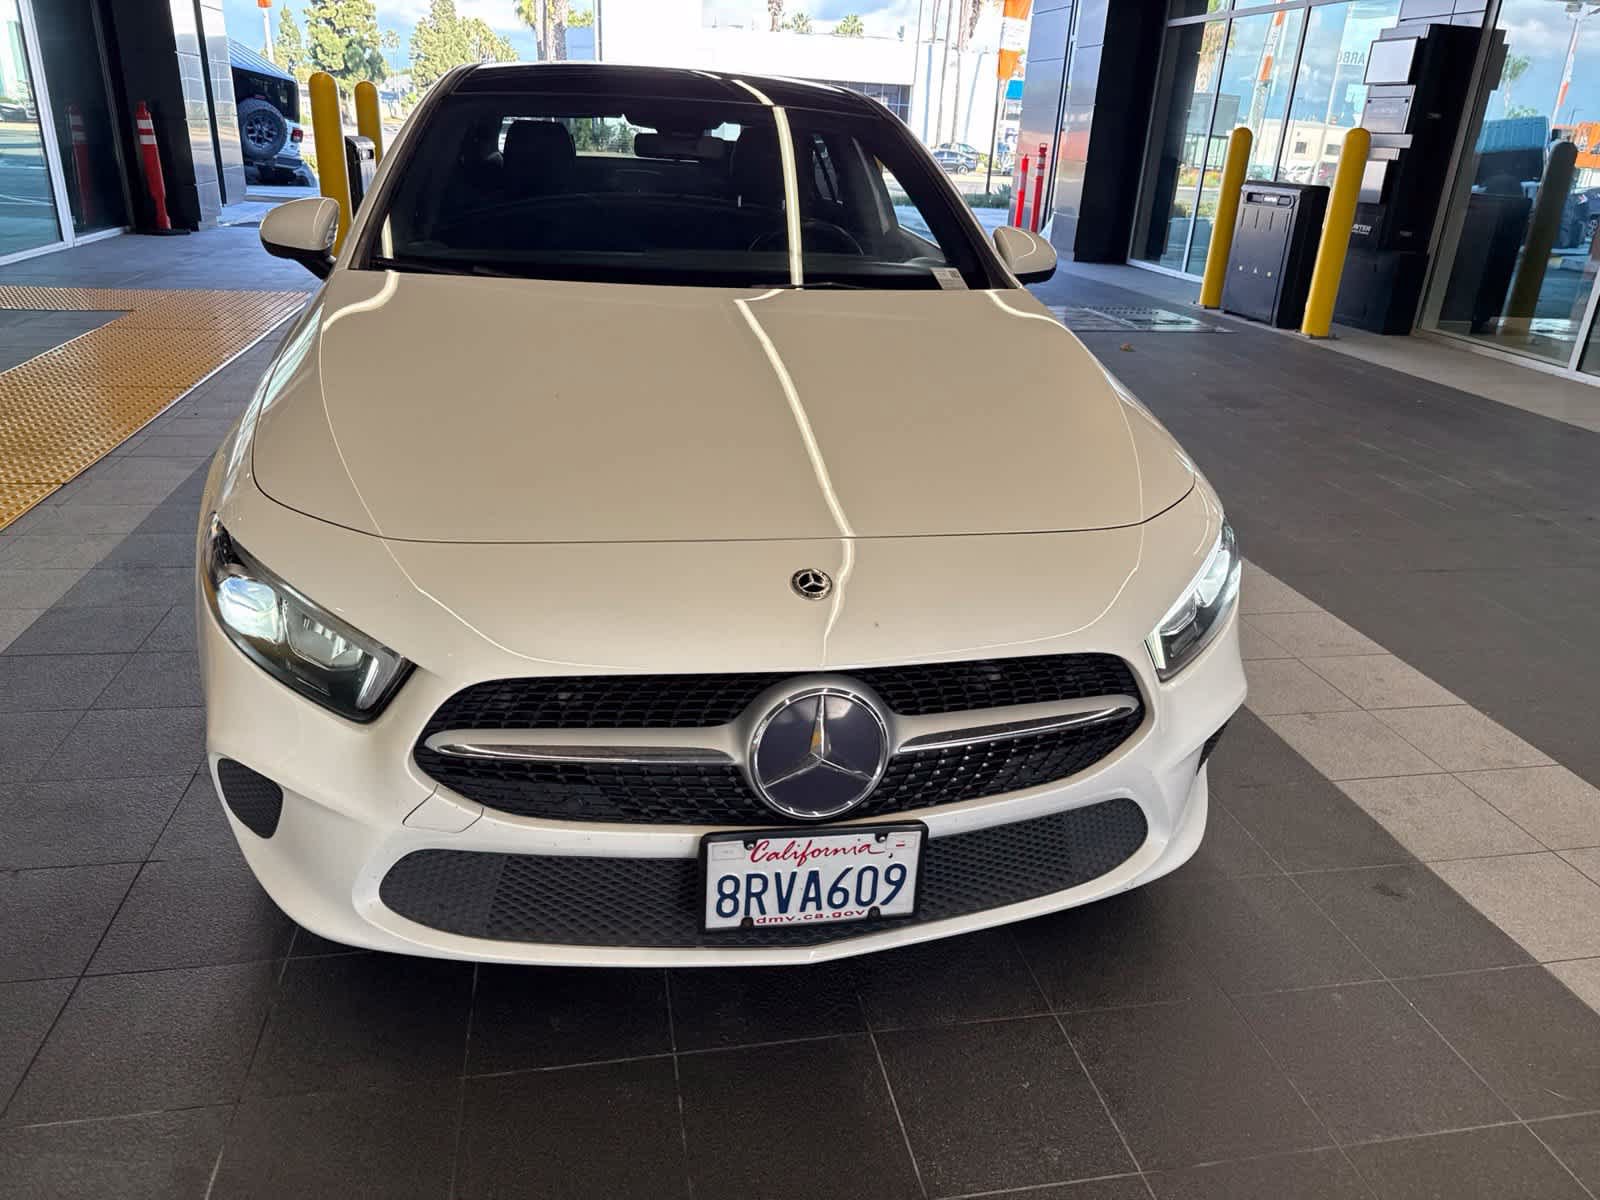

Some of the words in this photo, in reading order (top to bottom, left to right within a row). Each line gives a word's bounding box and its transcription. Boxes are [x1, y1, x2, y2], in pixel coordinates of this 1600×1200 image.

[750, 839, 884, 867] California
[716, 863, 907, 918] 8RVA609
[756, 910, 865, 924] dmv.ca.gov
